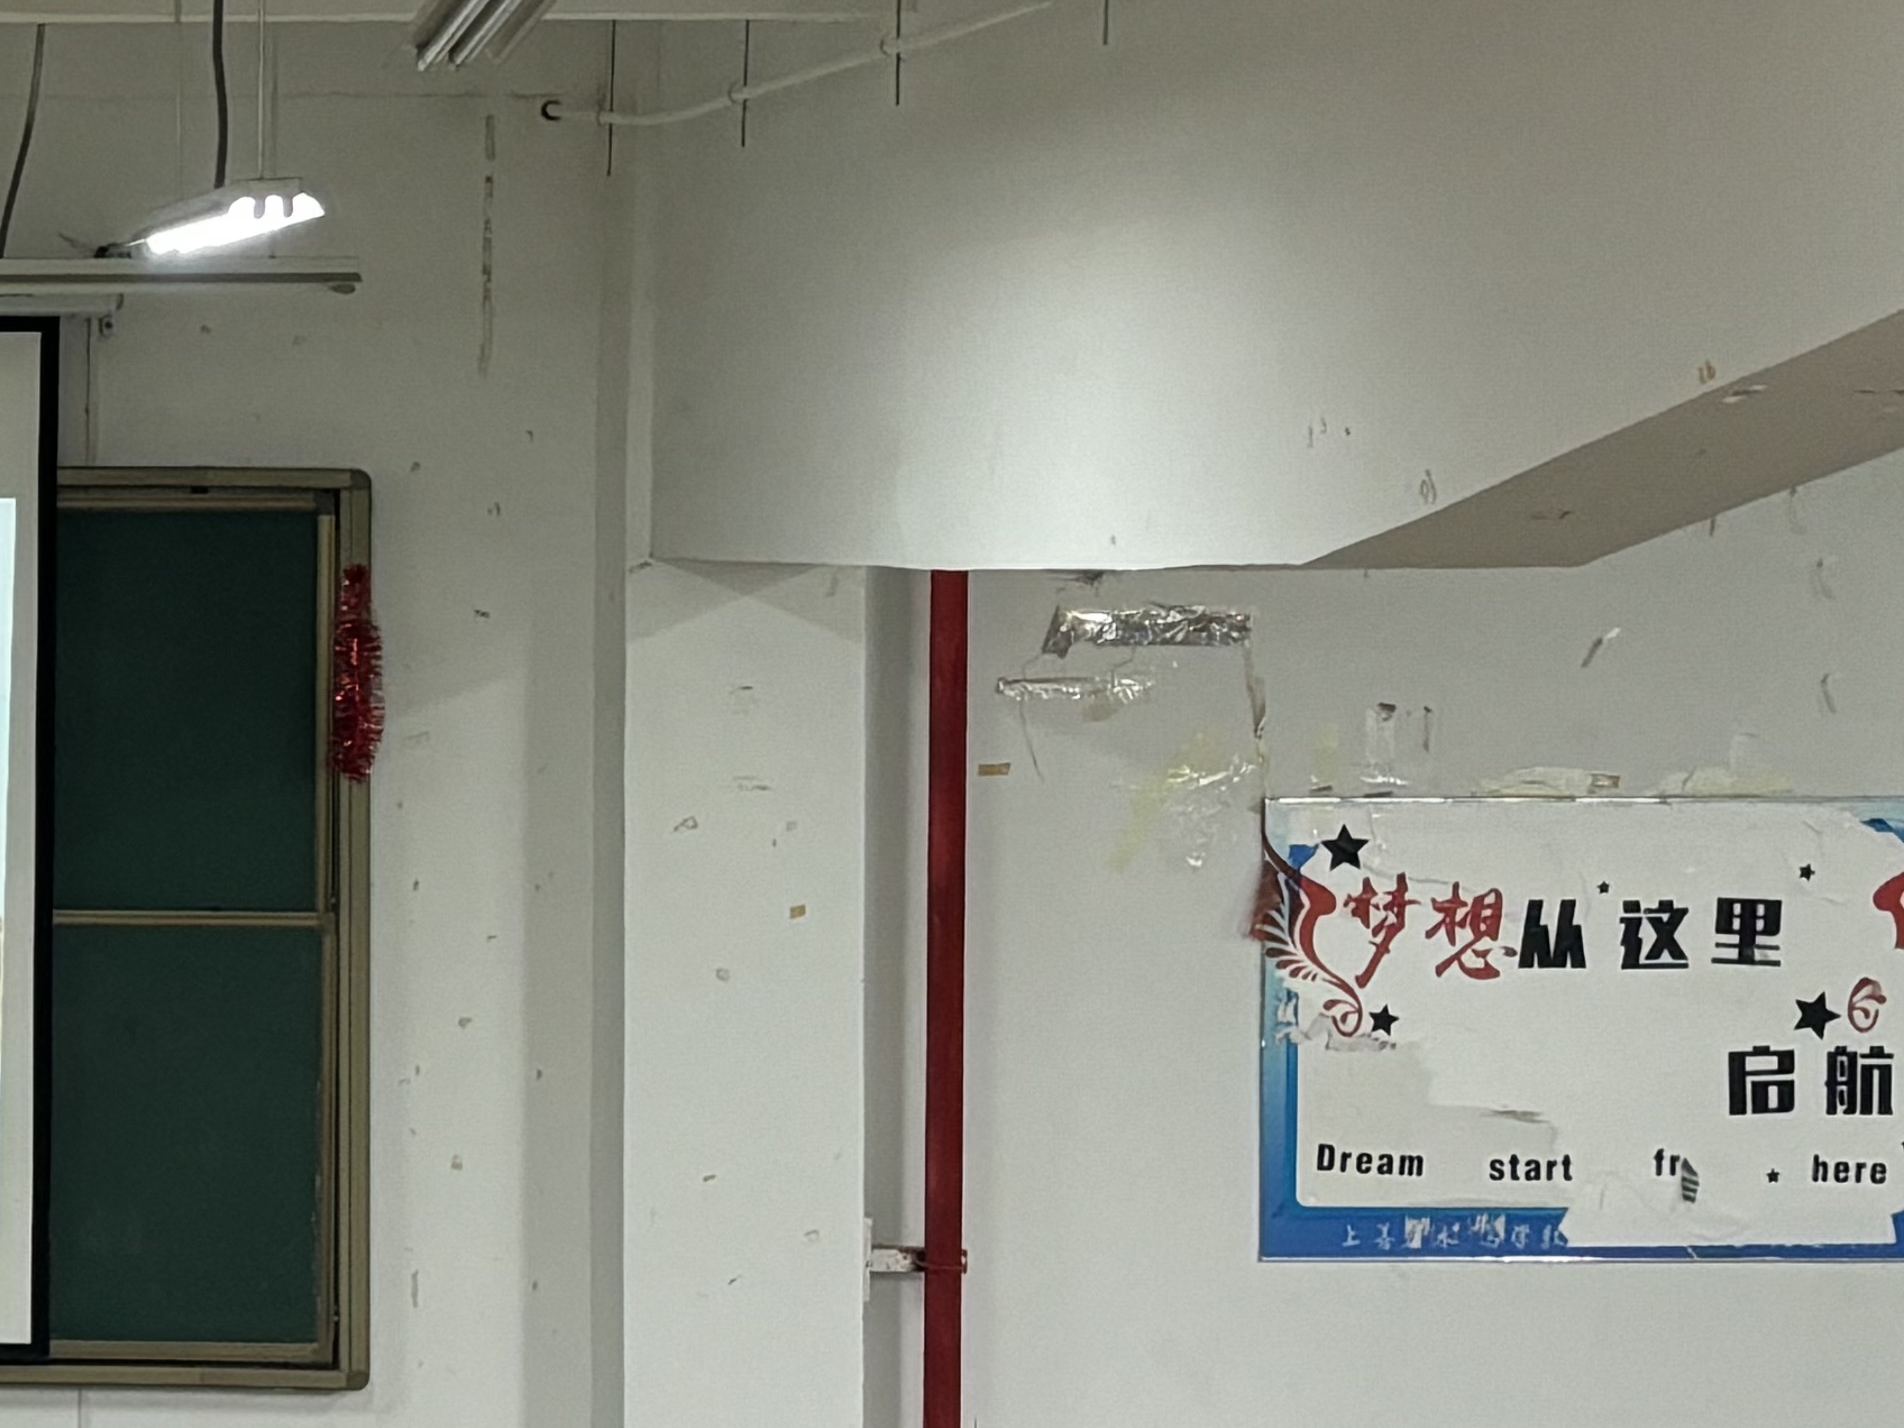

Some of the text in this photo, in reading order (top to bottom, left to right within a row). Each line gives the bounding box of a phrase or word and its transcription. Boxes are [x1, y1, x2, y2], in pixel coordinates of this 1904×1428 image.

[1728, 1045, 1894, 1116] 启航
[1317, 1143, 1425, 1177] Dream
[1489, 1154, 1573, 1182] start
[1812, 1154, 1888, 1184] here
